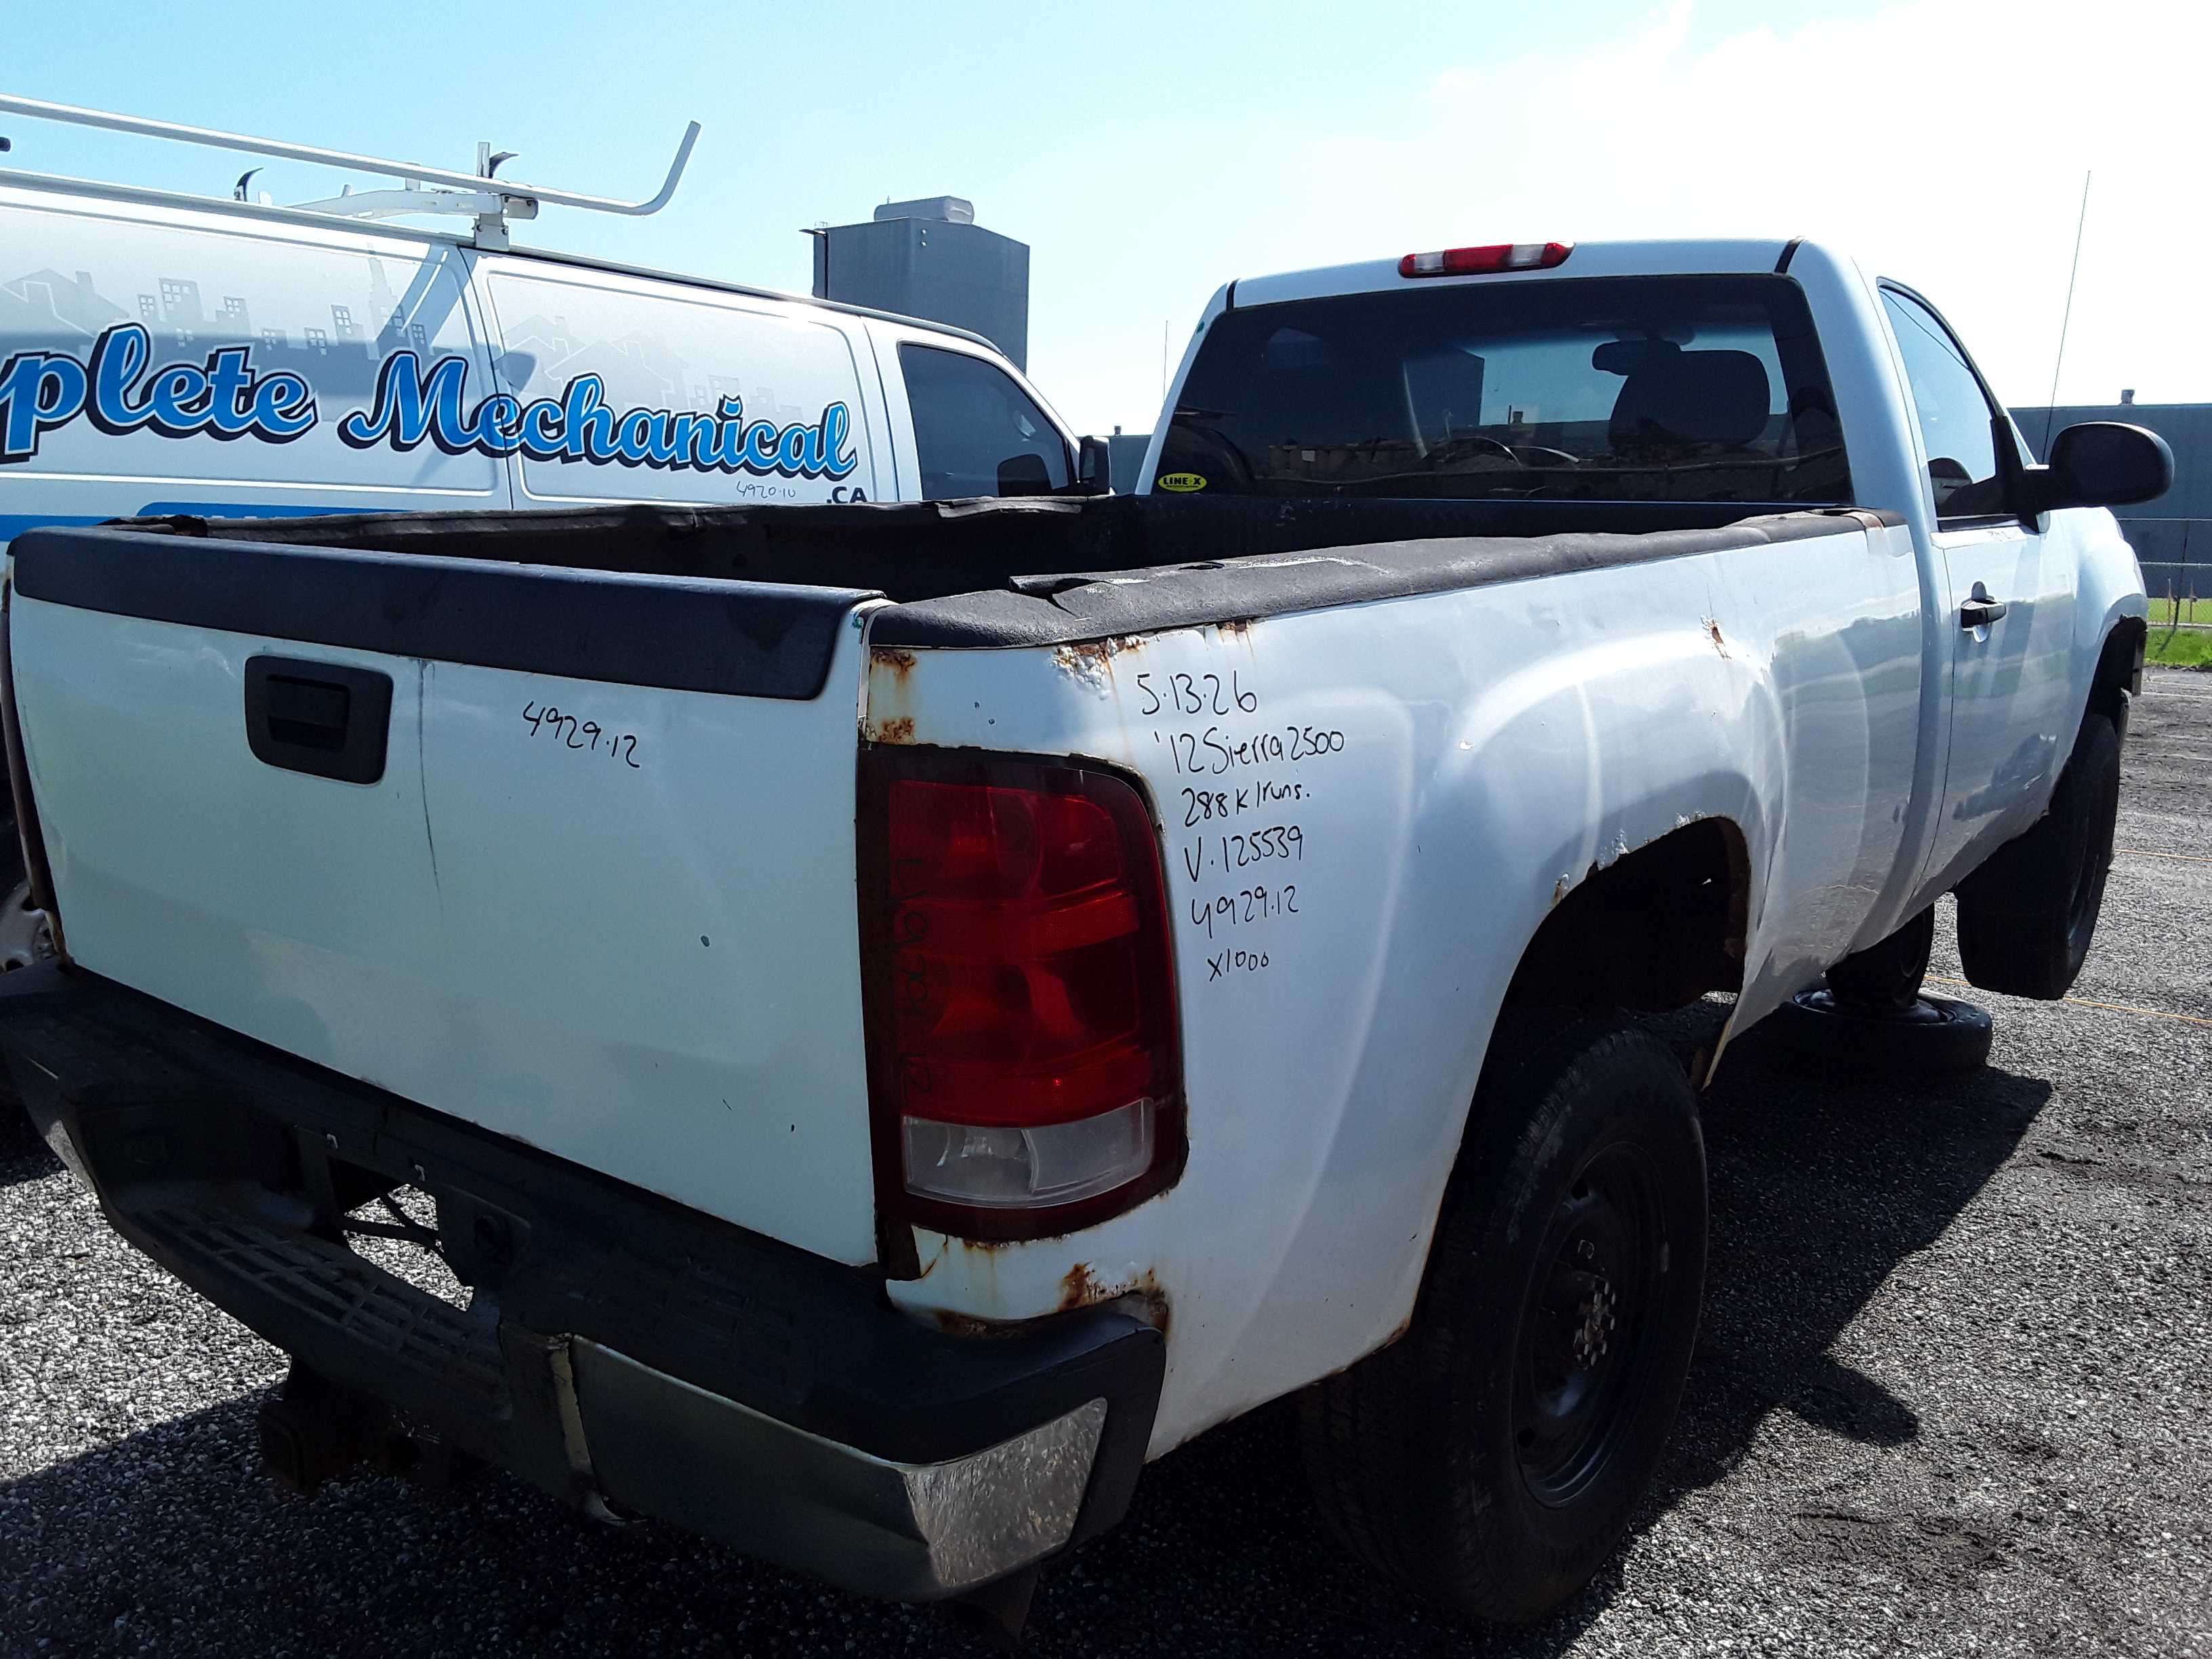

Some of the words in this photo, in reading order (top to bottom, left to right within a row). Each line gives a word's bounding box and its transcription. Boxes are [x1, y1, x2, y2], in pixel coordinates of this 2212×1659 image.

[337, 348, 859, 481] Mechanical
[826, 486, 867, 504] .CA
[522, 700, 640, 769] 4929.12
[1191, 884, 1300, 939] 4929.12
